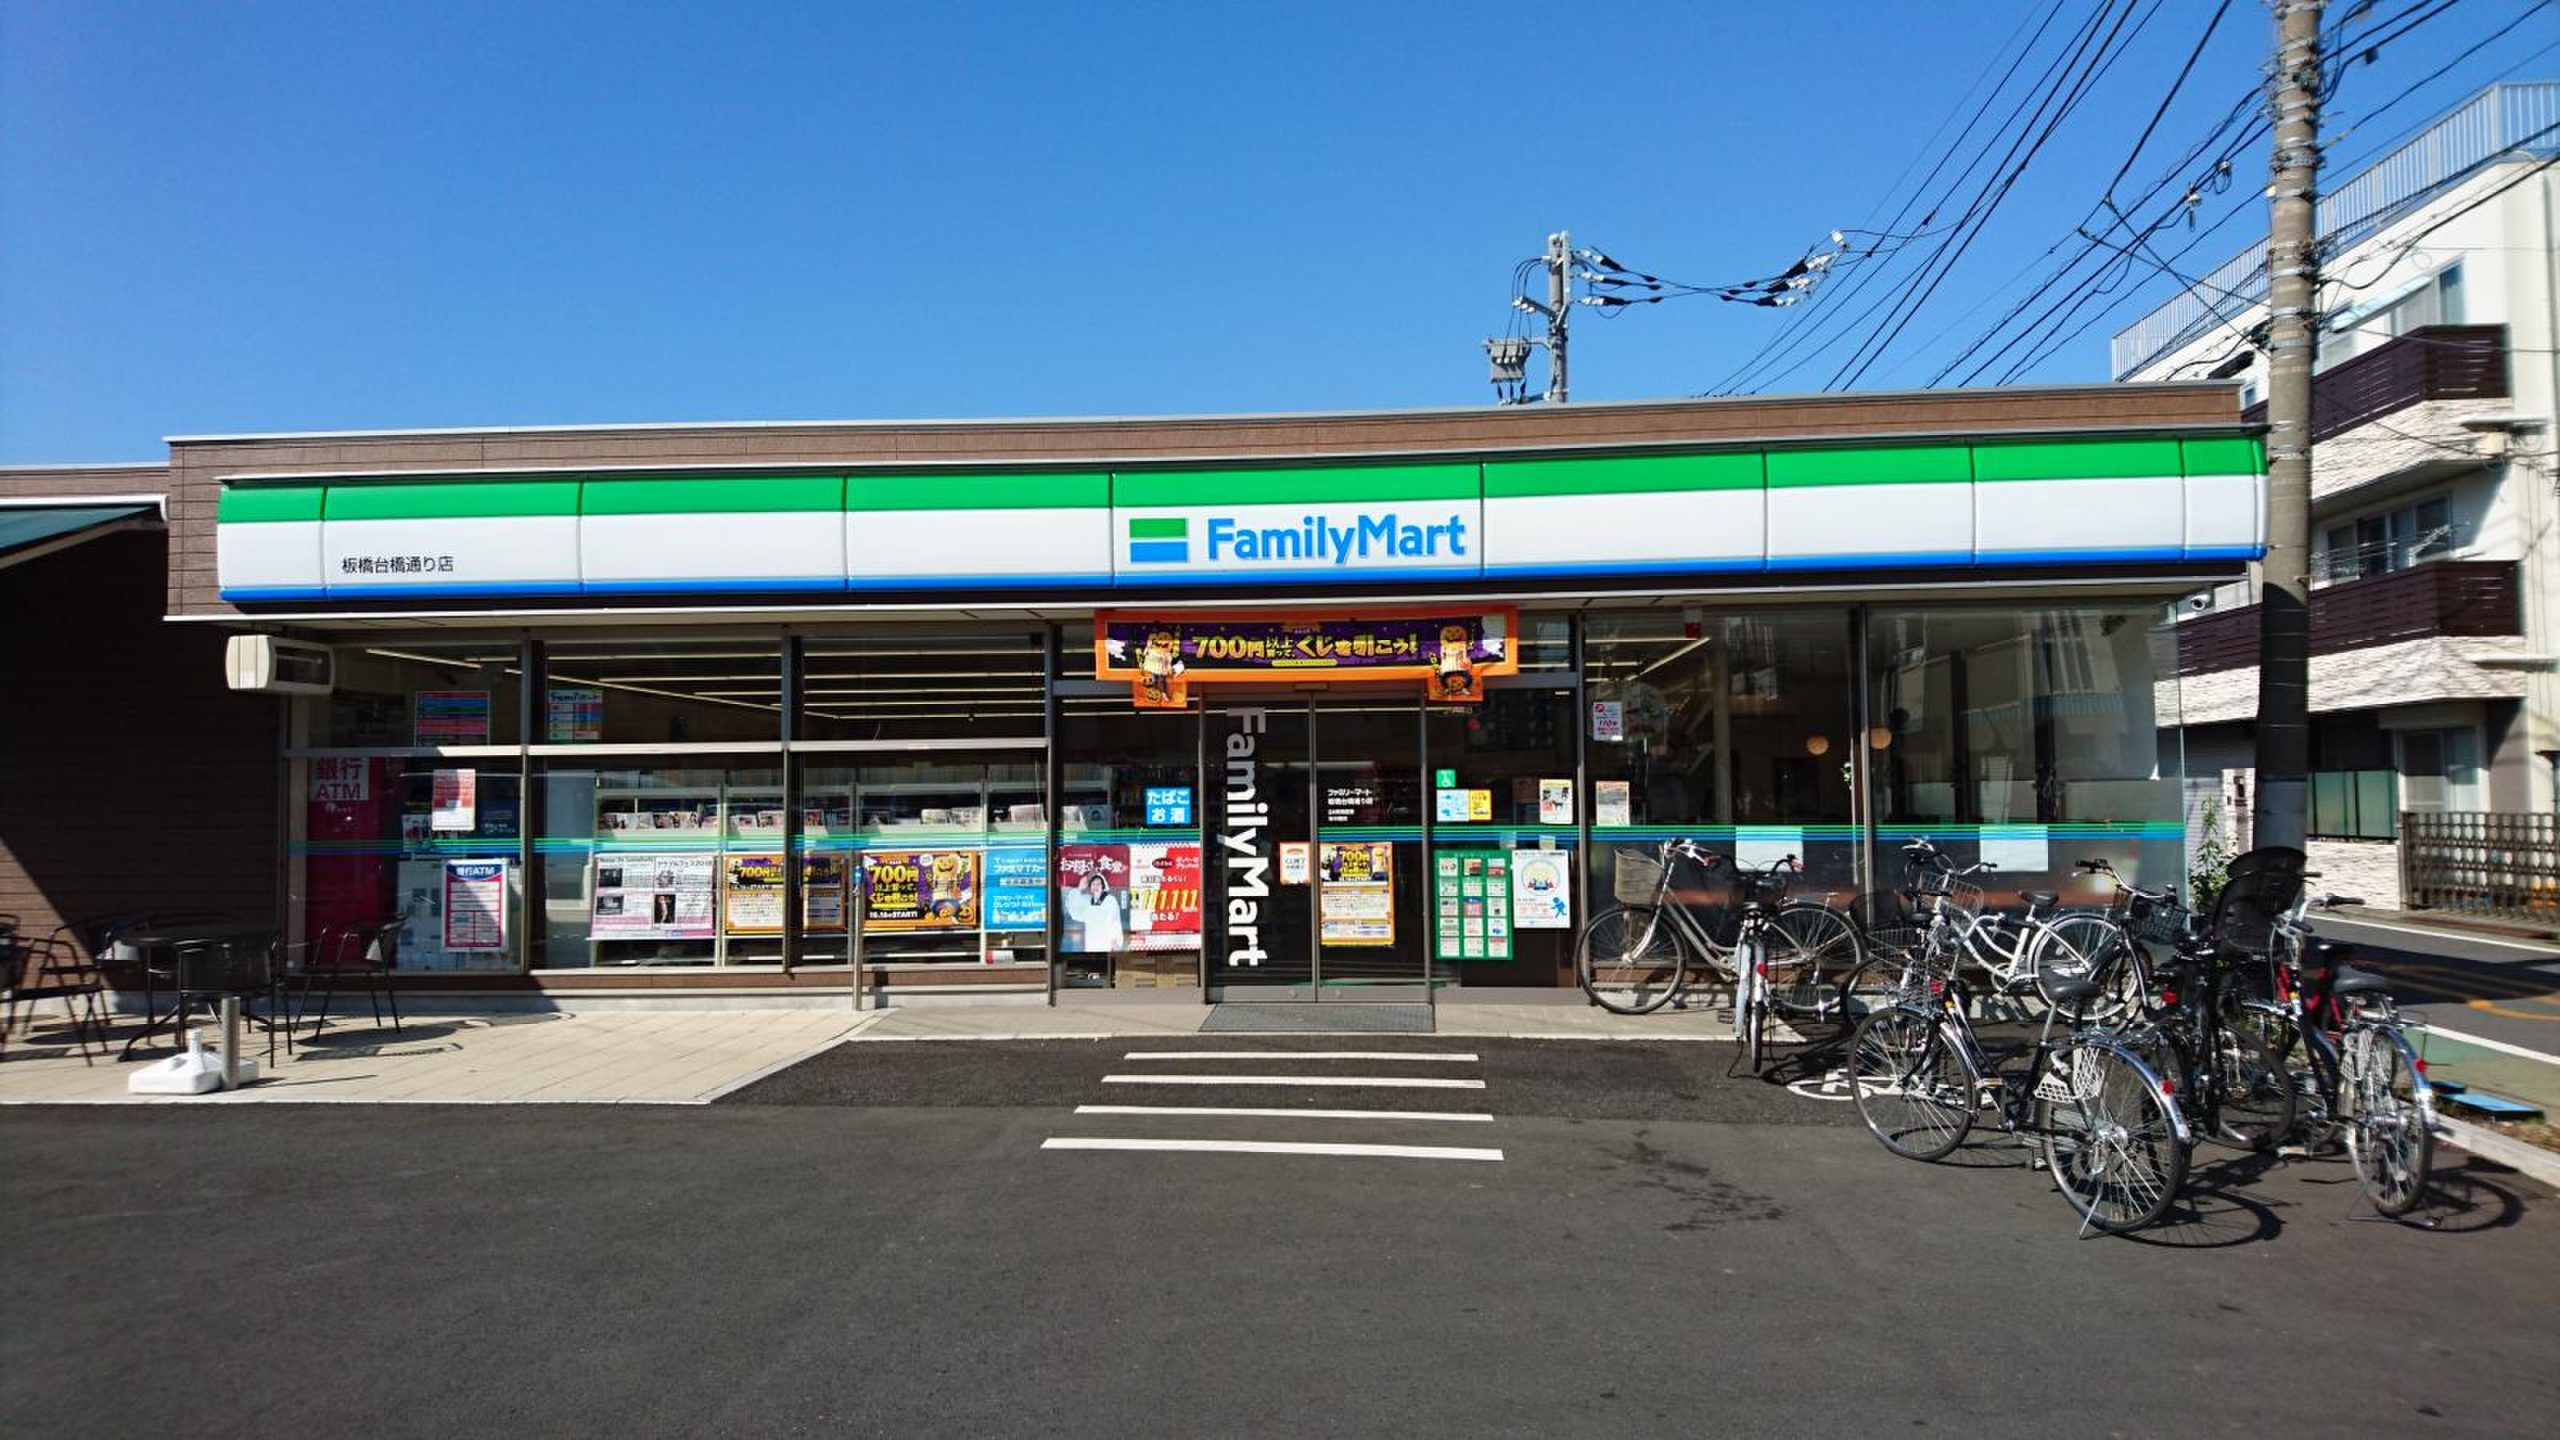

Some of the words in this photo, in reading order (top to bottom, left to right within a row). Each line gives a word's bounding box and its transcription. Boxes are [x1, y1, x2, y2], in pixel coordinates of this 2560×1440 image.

[1208, 514, 1466, 565] FamilyMart
[342, 556, 454, 574] 板橋台橋通り店
[1192, 635, 1264, 659] 700円
[315, 783, 362, 800] ATM
[1147, 790, 1190, 806] たばこ
[1217, 707, 1270, 967] FamilyMart
[868, 865, 919, 883] 700円
